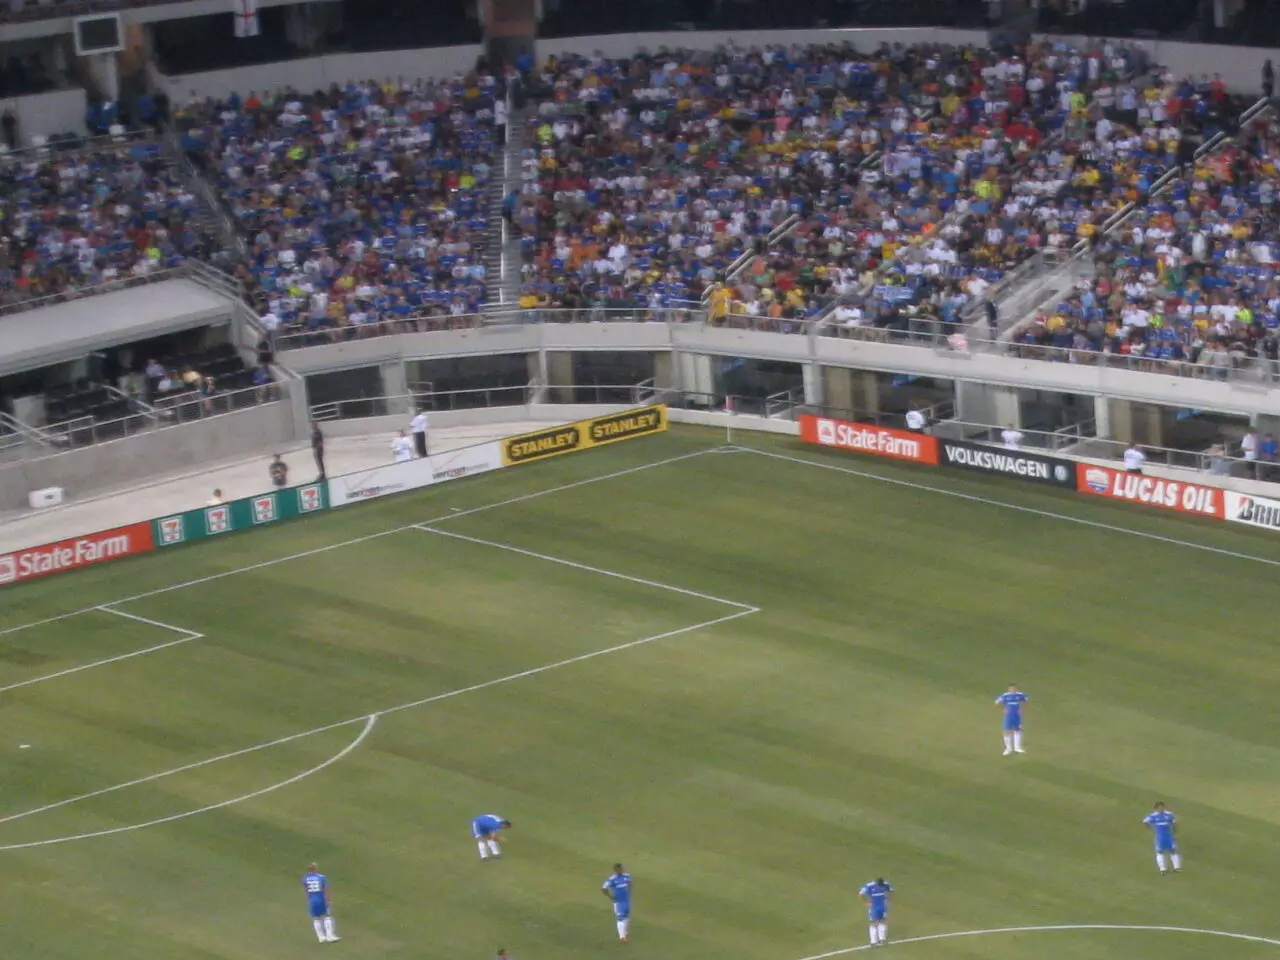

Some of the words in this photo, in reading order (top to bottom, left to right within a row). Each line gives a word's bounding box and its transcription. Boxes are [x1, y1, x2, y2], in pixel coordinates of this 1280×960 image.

[593, 413, 658, 438] STANLEY
[511, 432, 577, 457] STANLEY
[945, 445, 1048, 478] VOLKSWAGEN
[1113, 473, 1178, 506] LUCAS
[1183, 486, 1216, 513] OIL
